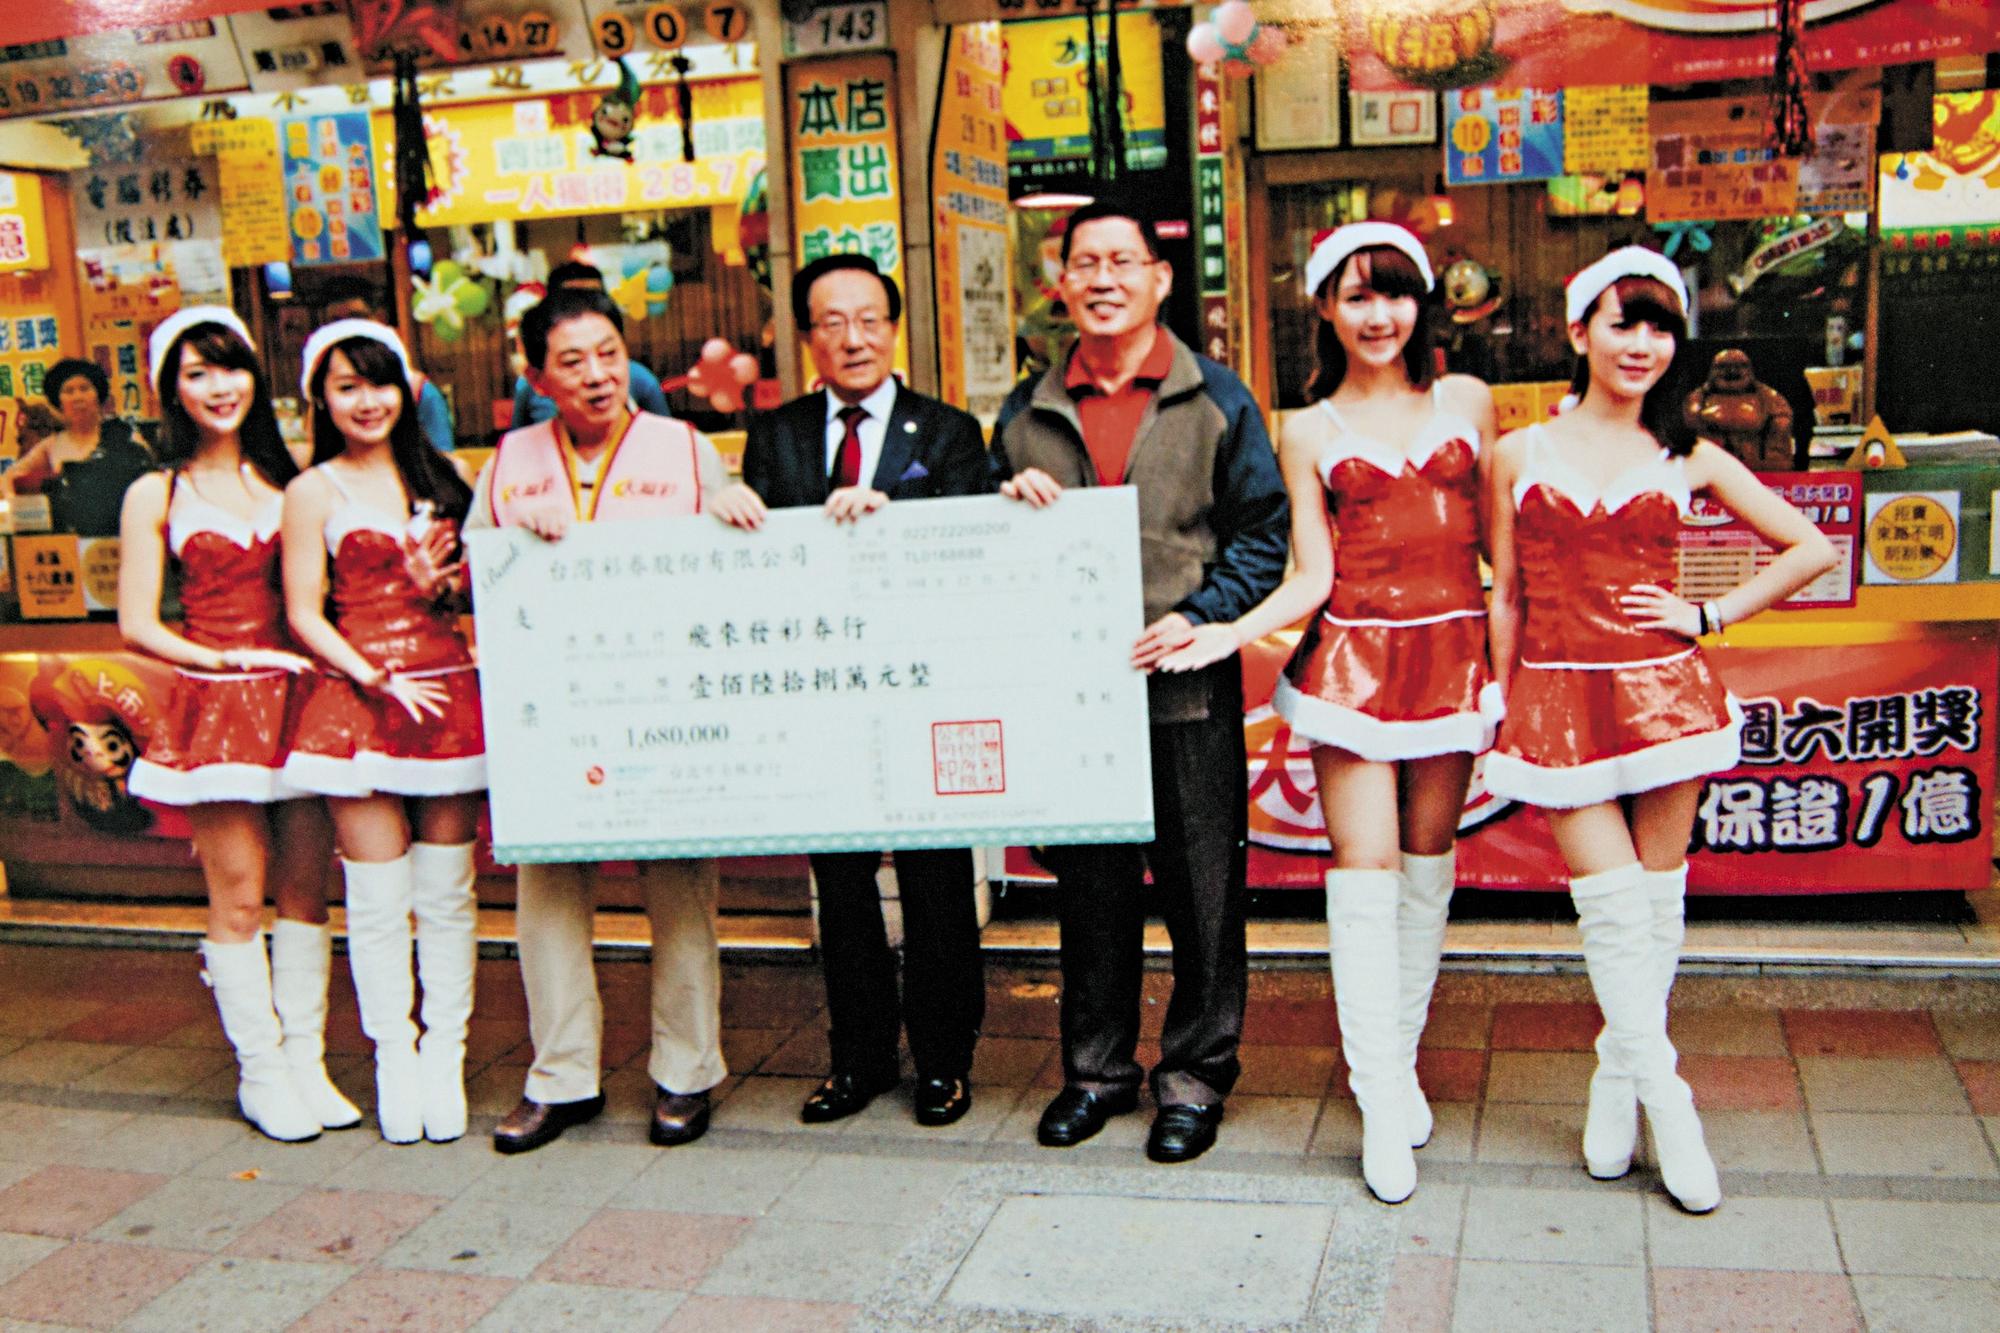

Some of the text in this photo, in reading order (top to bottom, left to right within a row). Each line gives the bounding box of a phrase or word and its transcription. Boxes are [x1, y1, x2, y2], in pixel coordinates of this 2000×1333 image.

[483, 26, 507, 47] 14
[524, 22, 550, 46] 27
[602, 7, 735, 50] 3 0 7
[819, 8, 875, 44] 143
[798, 78, 889, 135] 本店
[802, 144, 893, 200] 賣出
[549, 543, 809, 582] 台灣彩券股份有限公司
[1077, 566, 1100, 585] 78
[688, 613, 867, 649] 飛來發彩券行
[689, 662, 931, 701] 壹佰陸拾捌萬元整
[625, 722, 731, 752] 1,680,000
[1740, 687, 1978, 762] 週六開獎
[1697, 770, 1974, 848] 保證1億
